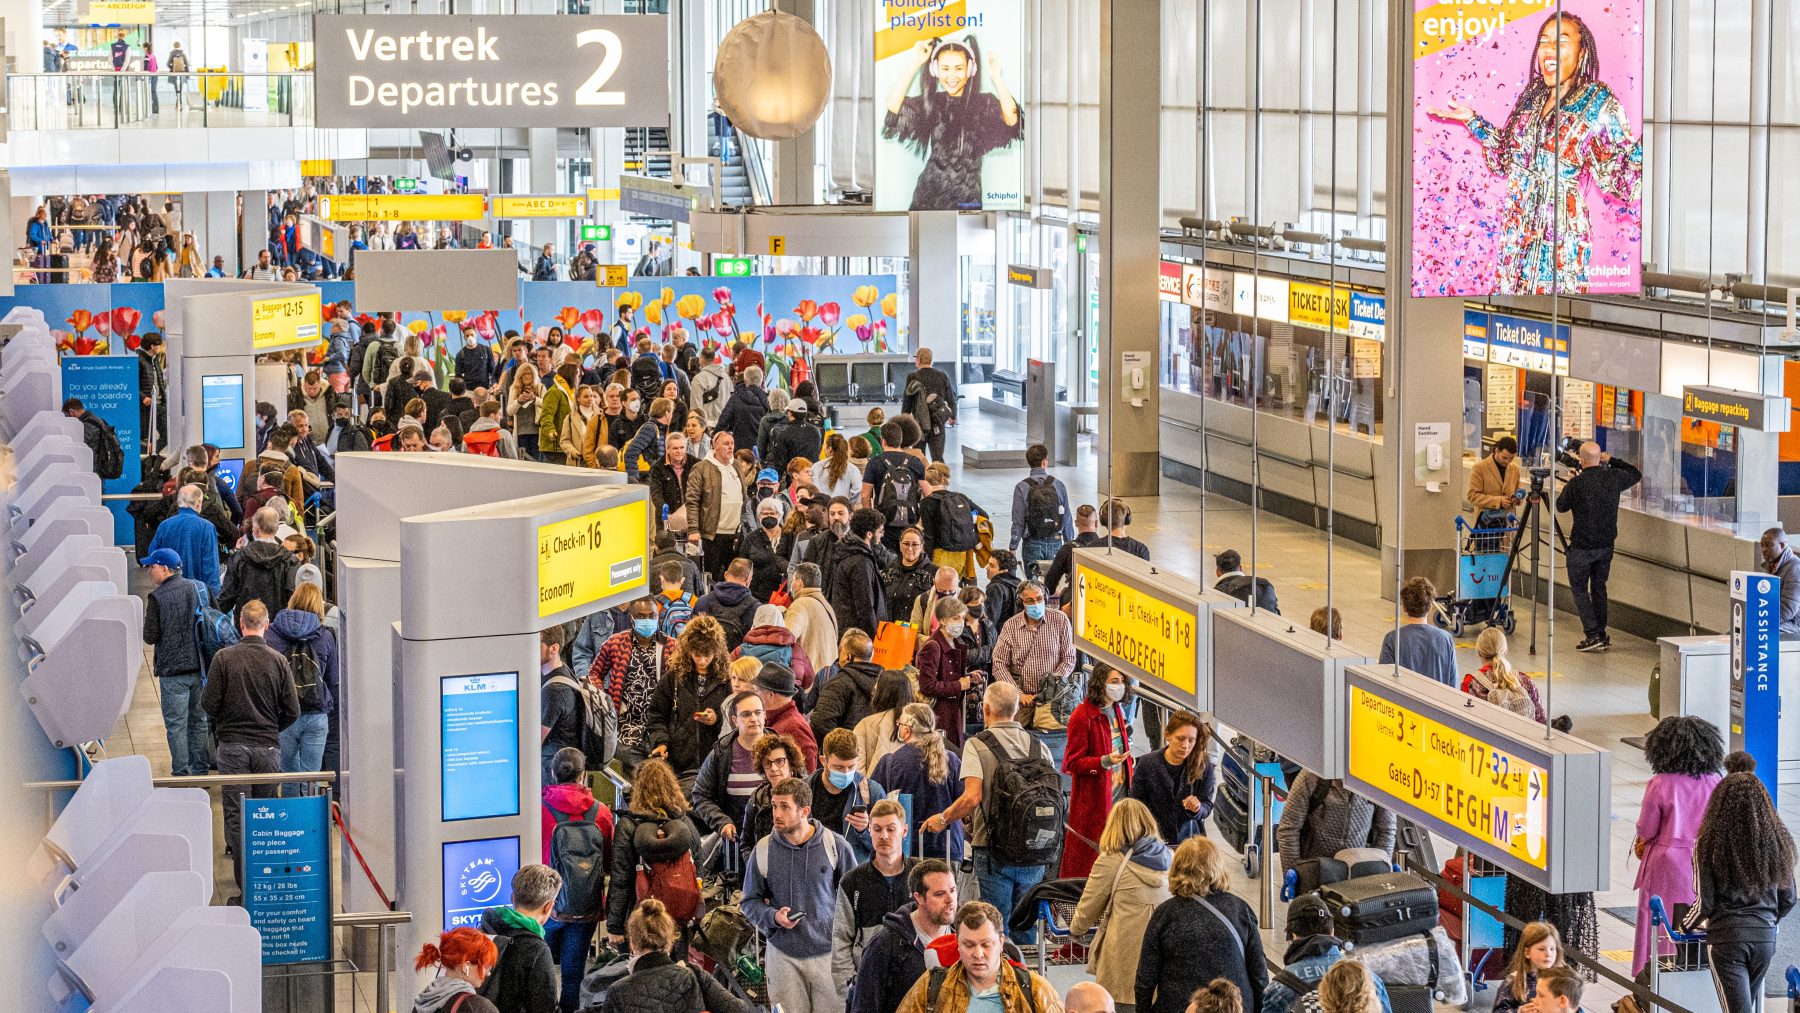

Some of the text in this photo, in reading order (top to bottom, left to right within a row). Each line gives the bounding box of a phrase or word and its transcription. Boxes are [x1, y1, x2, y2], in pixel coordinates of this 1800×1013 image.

[891, 12, 983, 31] playlist on!
[1424, 12, 1504, 41] enjoy!
[346, 27, 500, 62] Vertrek
[575, 28, 626, 105] 2
[349, 75, 558, 114] Departures
[987, 192, 1018, 201] Schiphol
[384, 210, 399, 218] 1-8
[774, 239, 781, 253] F
[1584, 264, 1631, 278] Schiphol
[1159, 276, 1181, 293] ERVICE
[262, 303, 282, 314] Baggage
[283, 301, 303, 317] 12-15
[1292, 292, 1322, 312] TICKET
[1324, 296, 1348, 317] DSK
[1353, 299, 1374, 319] Ticket
[254, 331, 275, 341] Economy
[1495, 322, 1520, 344] Ticket
[1520, 326, 1541, 347] Desk
[69, 382, 128, 393] Do you already
[97, 391, 132, 401] boarding
[101, 402, 117, 410] your
[1694, 397, 1749, 420] Baggage repacking
[553, 521, 602, 554] Check-in 16
[611, 563, 642, 580] Passengers only
[540, 581, 574, 602] Economy
[1094, 577, 1116, 598] Departures
[1118, 592, 1122, 616] 1
[1137, 605, 1159, 629] Check-in
[1175, 618, 1190, 648] 1-8
[1094, 624, 1107, 643] Gates
[1758, 598, 1768, 691] ASSISTANCE
[1377, 721, 1394, 739] Vertrek
[1361, 691, 1509, 790] Departures 3 Check-in 17-32
[1388, 763, 1411, 788] Gates
[274, 830, 304, 838] Baggage
[460, 858, 493, 896] SKYTEAM
[263, 883, 272, 891] kg
[272, 948, 298, 956] checked
